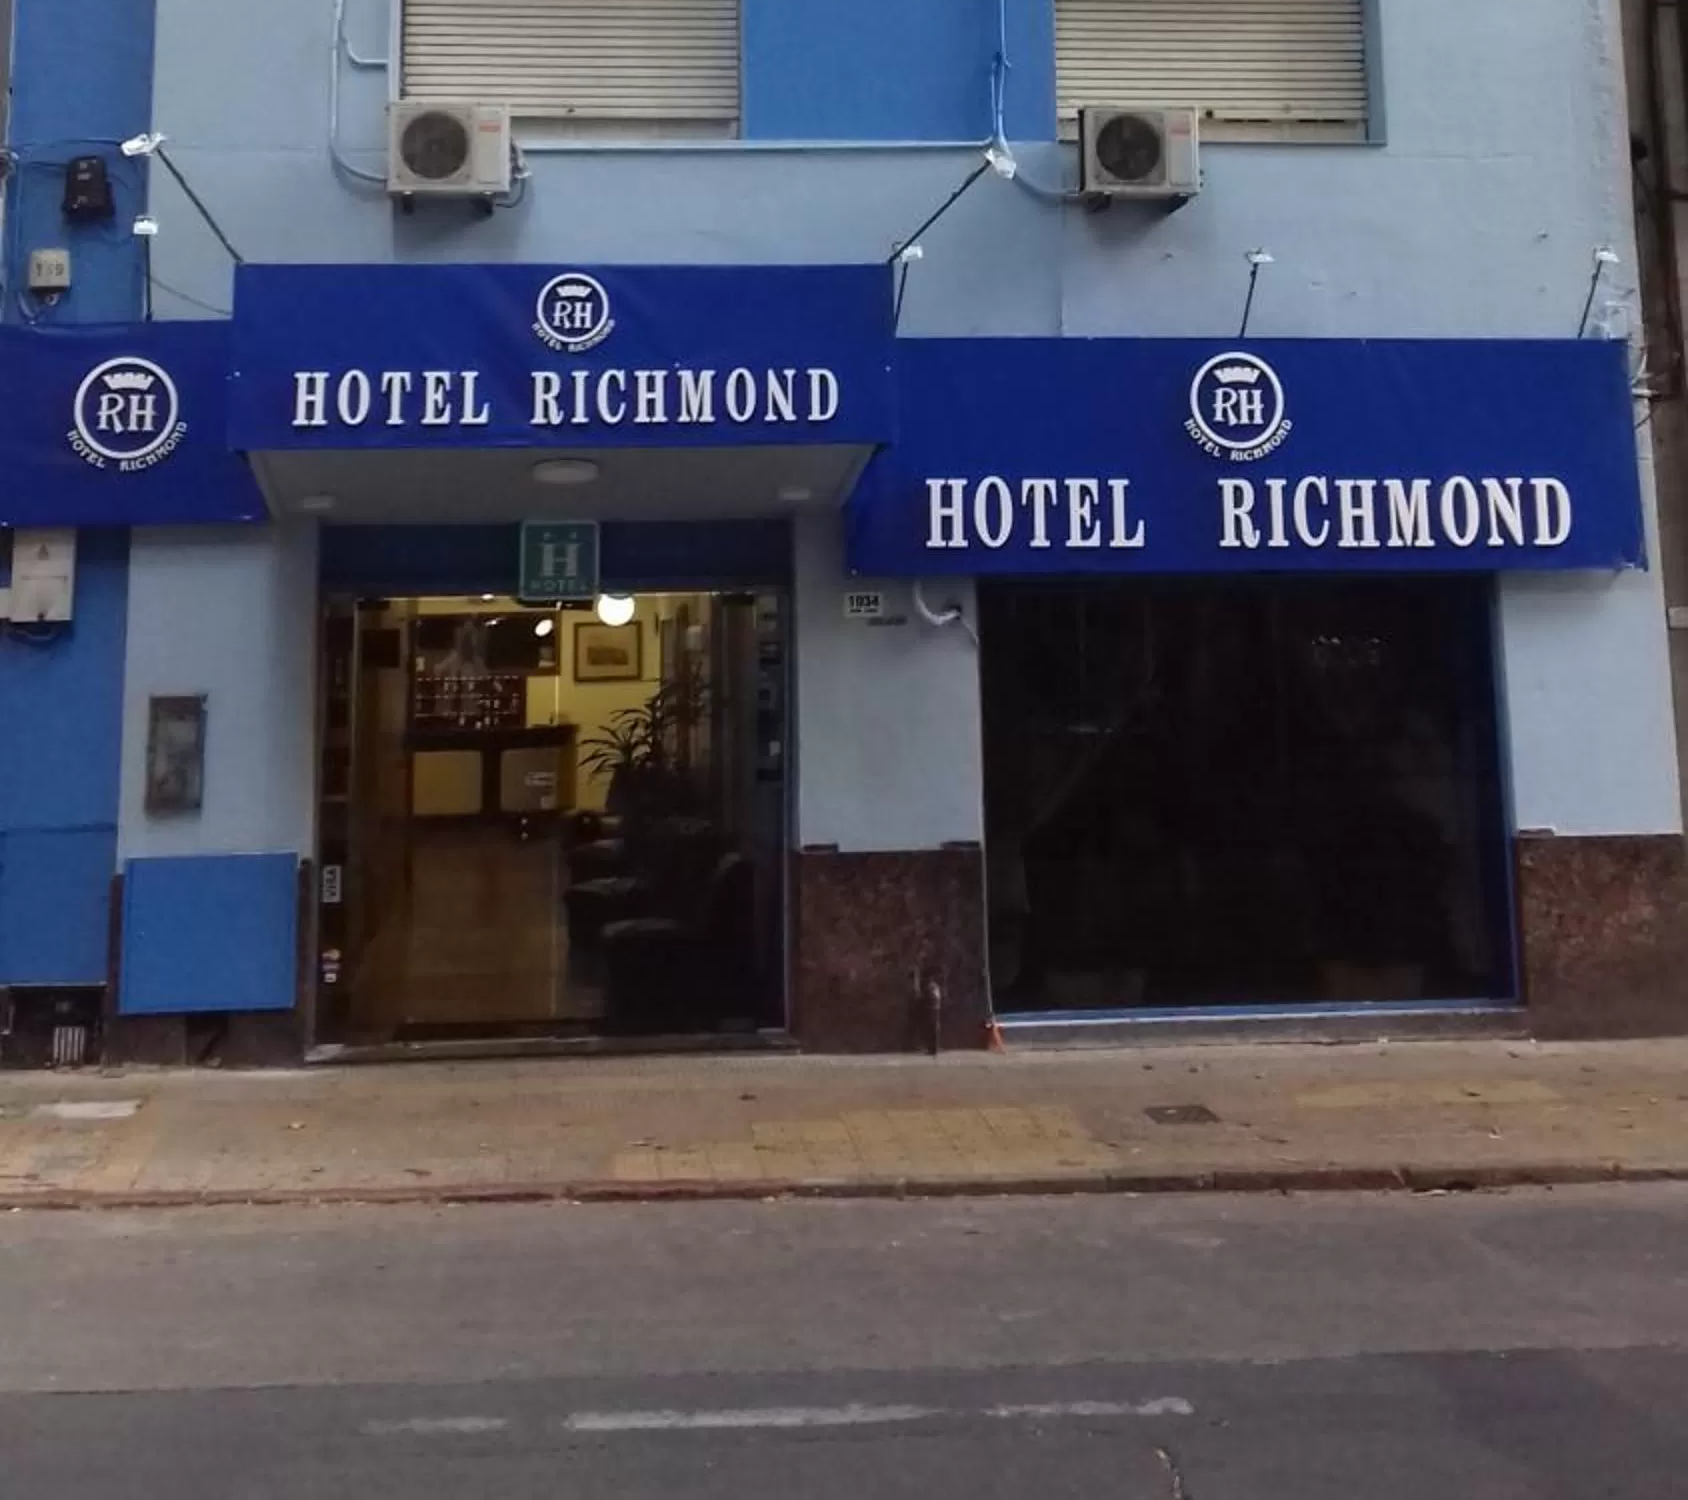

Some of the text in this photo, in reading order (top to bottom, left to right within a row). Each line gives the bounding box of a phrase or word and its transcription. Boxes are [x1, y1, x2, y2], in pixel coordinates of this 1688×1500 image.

[552, 300, 593, 329] RH
[96, 392, 158, 434] RH
[292, 367, 840, 426] HOTEL RICHMOND
[1212, 387, 1264, 427] RH
[67, 420, 188, 472] HOTEL RICHMOND
[1183, 418, 1293, 461] HOTEL RICHMOND
[925, 475, 1573, 549] HOTEL RICHMOND
[538, 542, 583, 577] H
